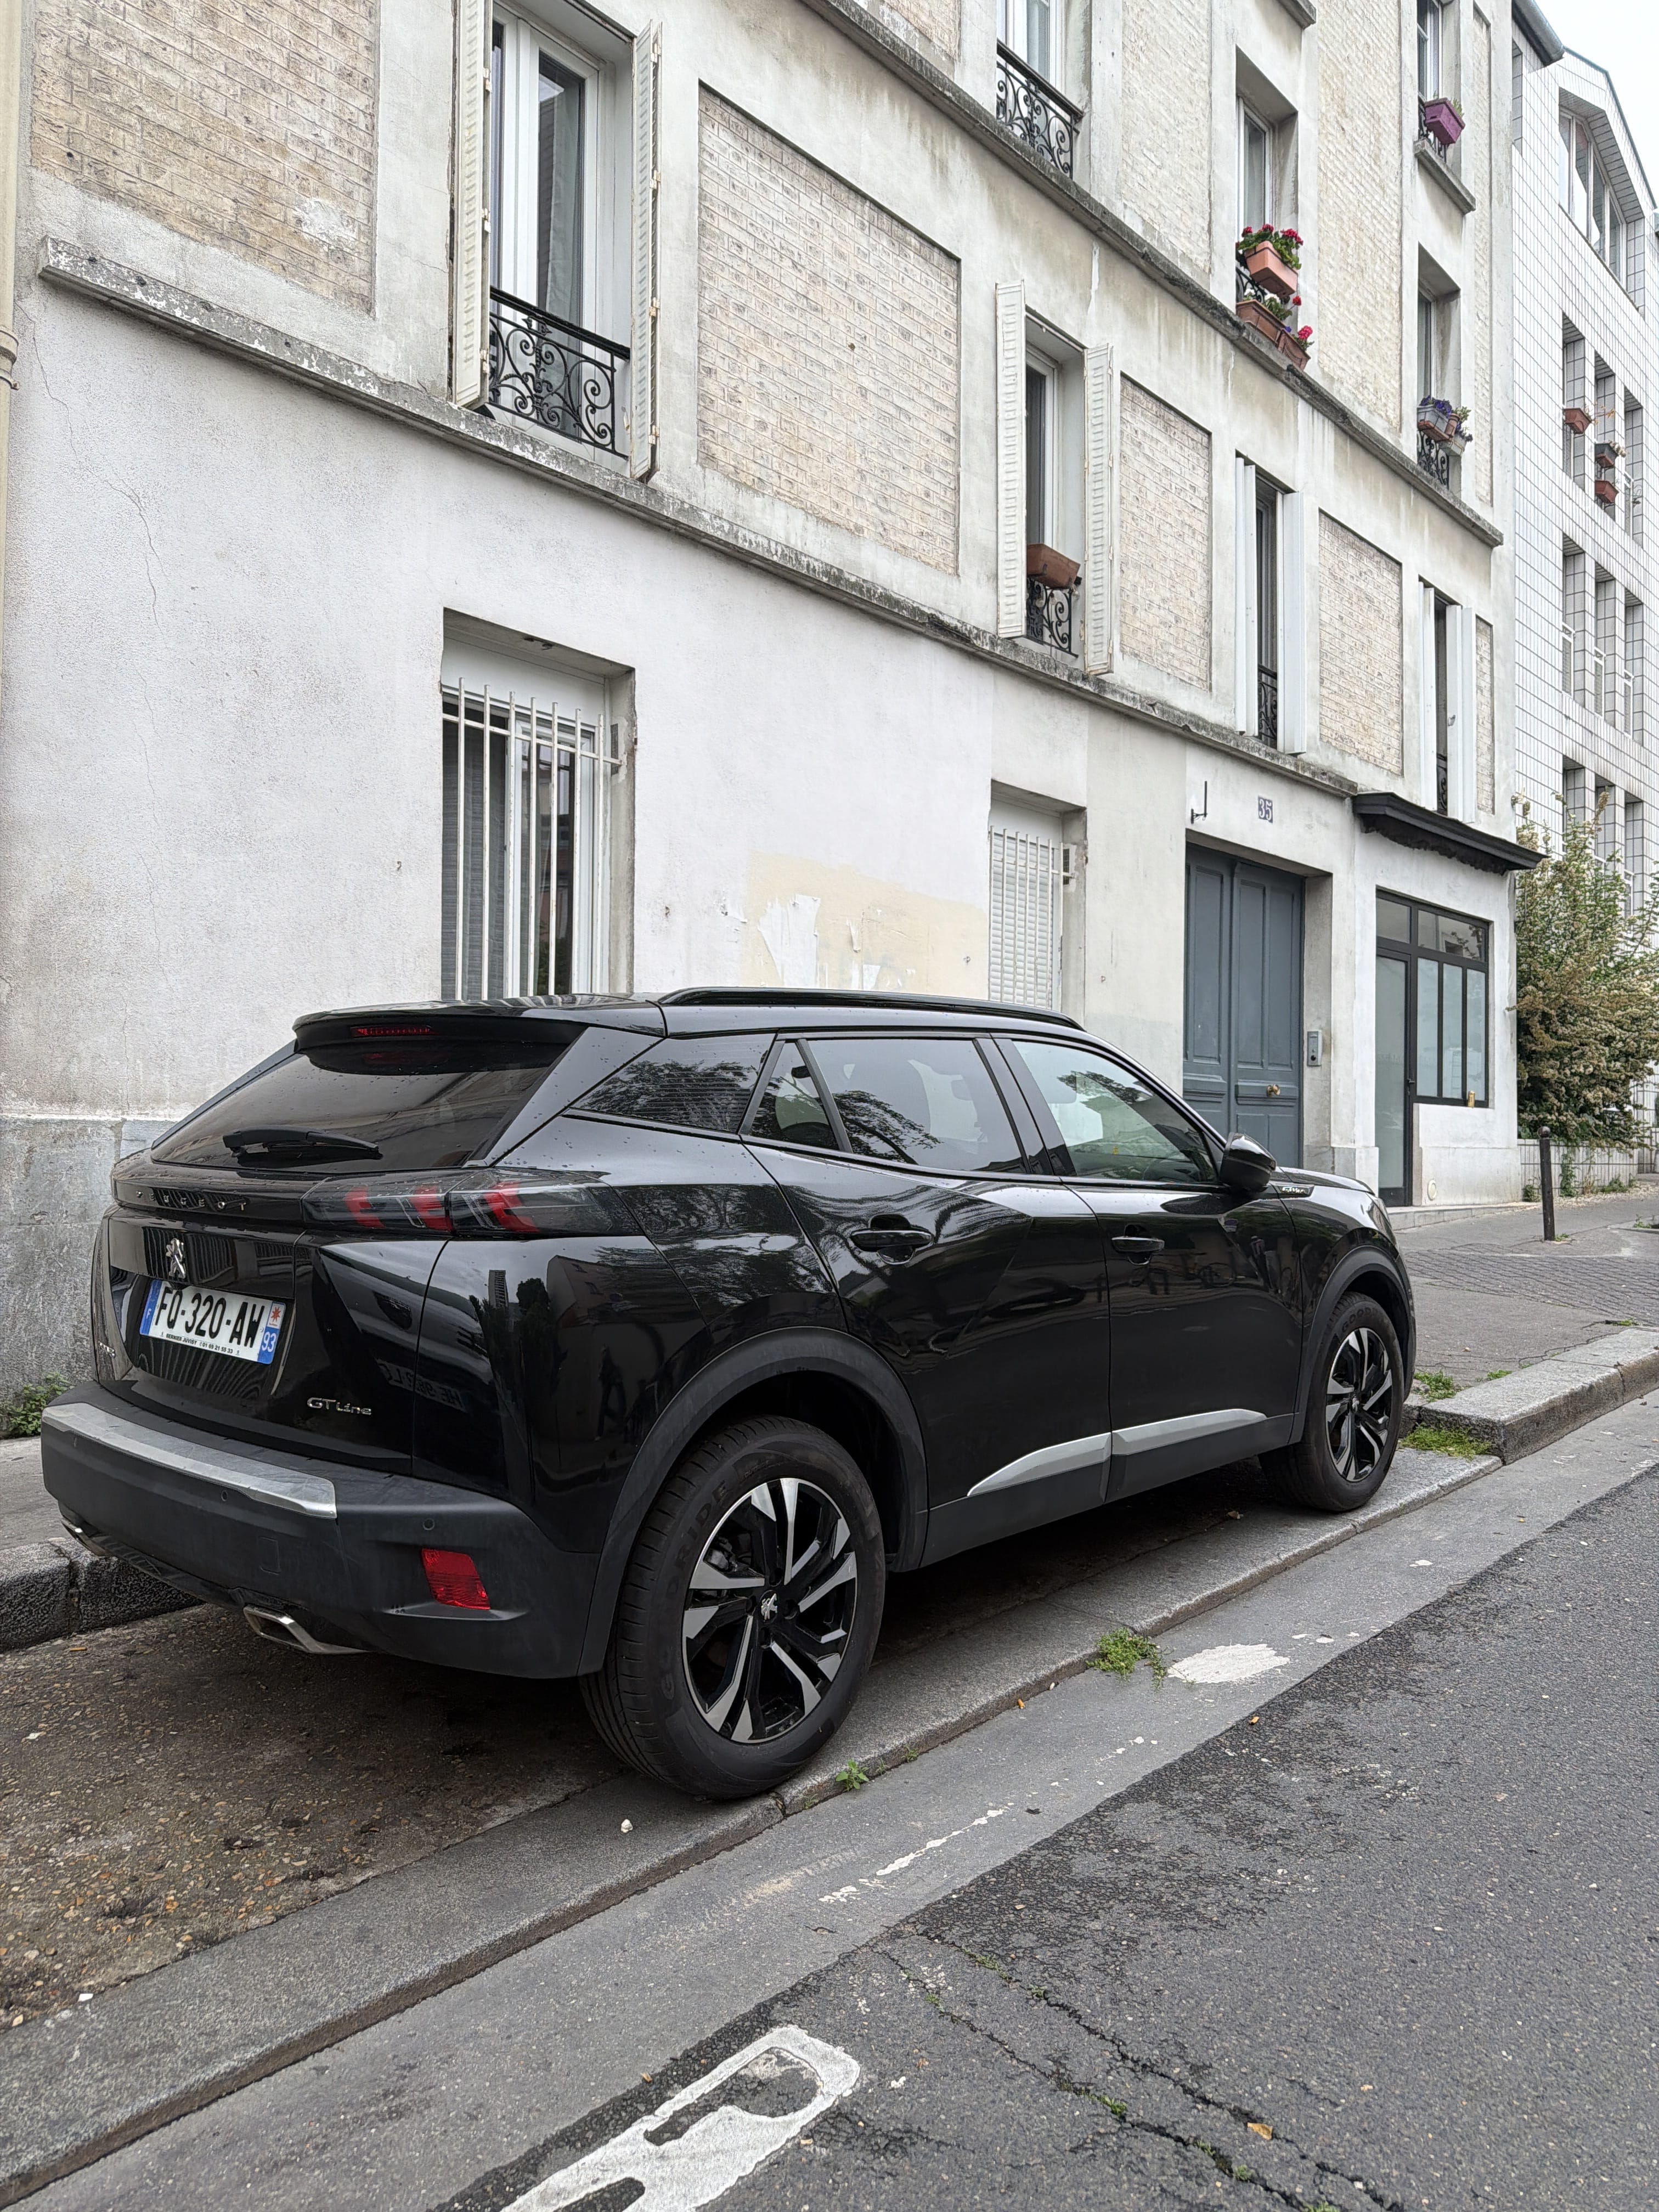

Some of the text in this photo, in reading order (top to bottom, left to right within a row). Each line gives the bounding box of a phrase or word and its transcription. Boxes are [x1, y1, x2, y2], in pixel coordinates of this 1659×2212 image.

[1259, 798, 1272, 821] 35
[136, 1190, 247, 1211] PEUGEOT
[166, 1333, 182, 1341] BERNIER
[182, 1336, 198, 1345] JUVISY
[261, 1331, 276, 1352] 93
[307, 1397, 372, 1415] GT Line
